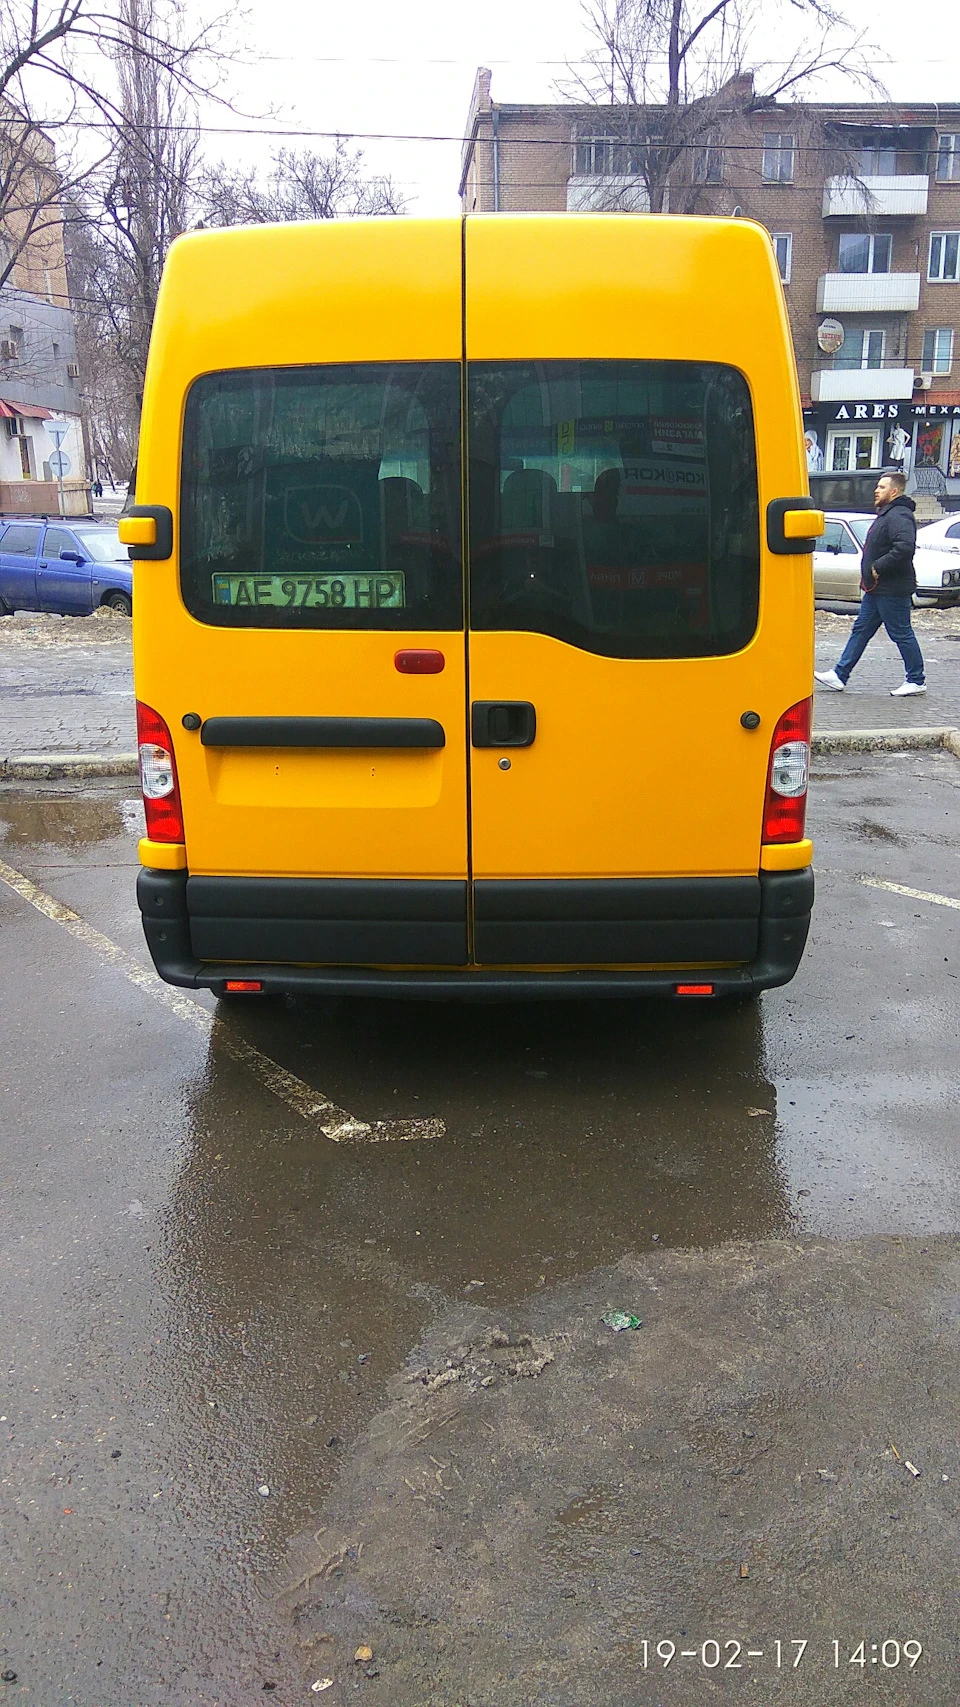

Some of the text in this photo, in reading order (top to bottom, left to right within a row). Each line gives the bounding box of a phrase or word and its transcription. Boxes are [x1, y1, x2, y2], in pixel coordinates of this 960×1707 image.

[835, 404, 899, 419] ARES
[235, 579, 395, 607] AE 9758 HP
